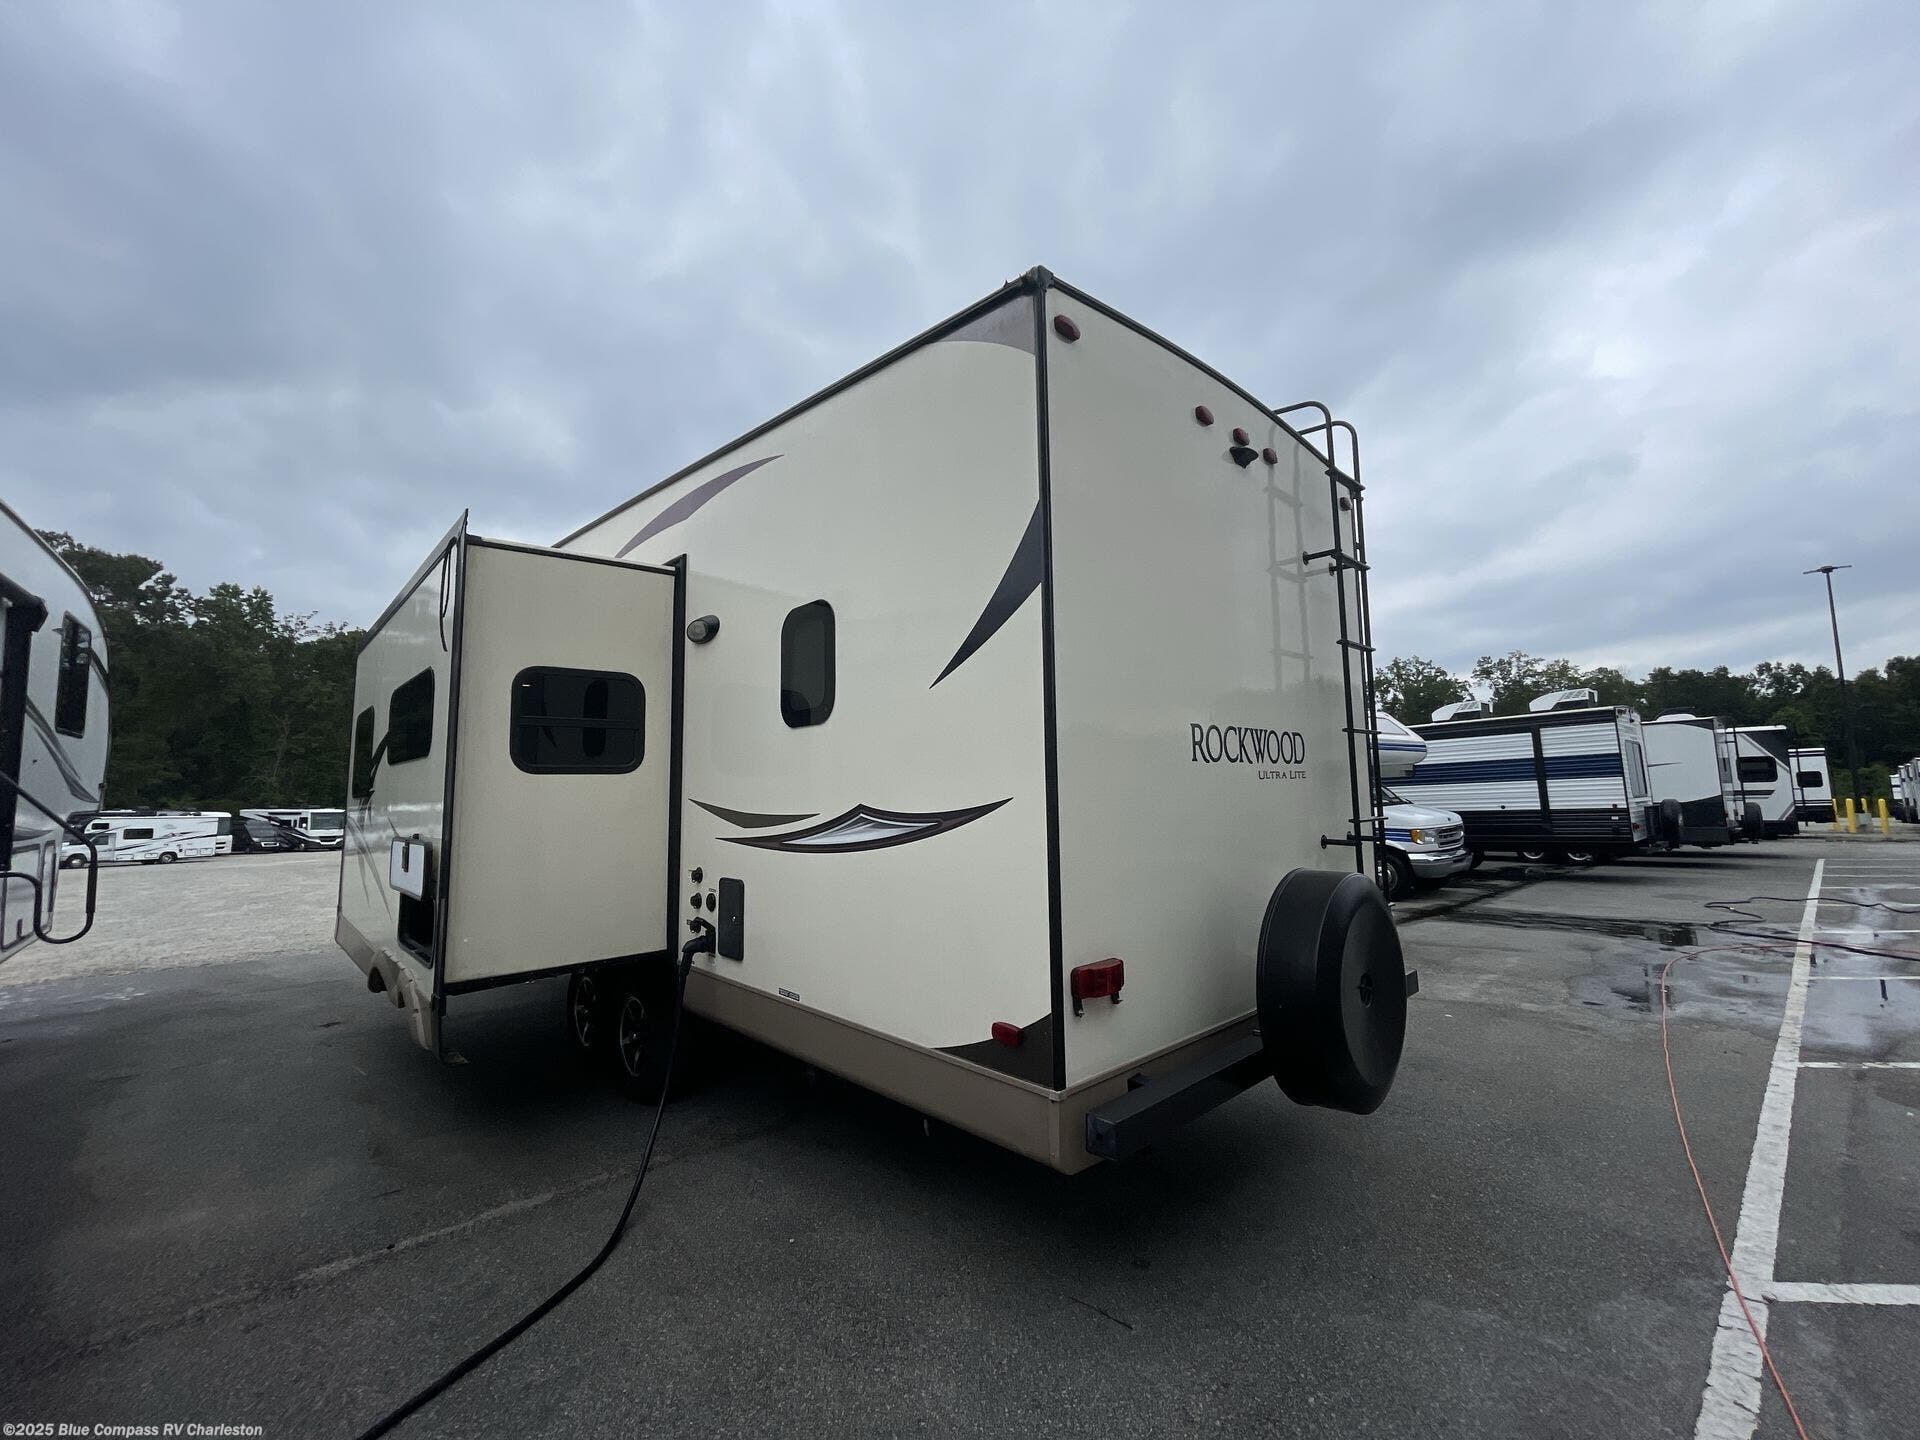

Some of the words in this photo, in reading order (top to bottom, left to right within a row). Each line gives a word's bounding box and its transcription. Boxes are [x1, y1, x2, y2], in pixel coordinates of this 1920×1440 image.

[1190, 723, 1305, 764] ROCKWOOD
[1258, 770, 1287, 780] ULTRA
[1289, 770, 1306, 780] LITE
